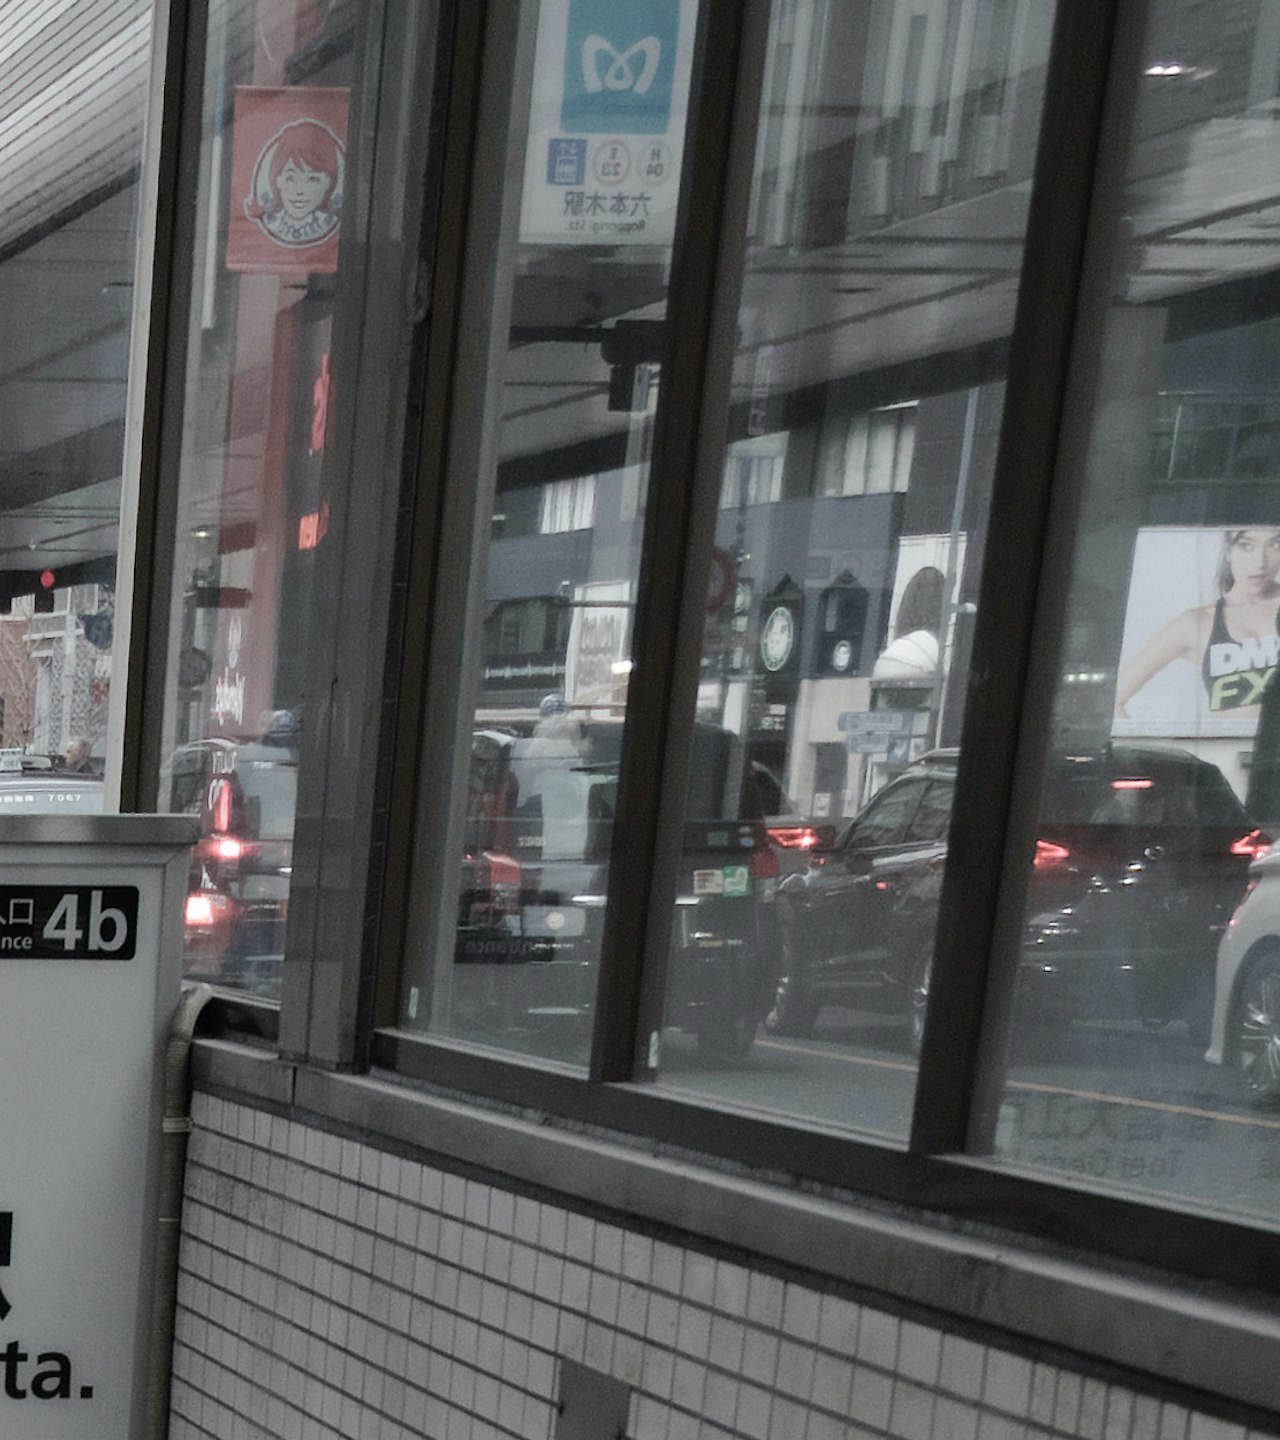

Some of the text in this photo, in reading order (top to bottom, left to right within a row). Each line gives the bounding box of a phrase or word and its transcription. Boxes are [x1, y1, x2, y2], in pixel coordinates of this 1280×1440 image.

[1210, 635, 1280, 677] DM
[1210, 667, 1277, 710] FX
[42, 889, 130, 953] 4b
